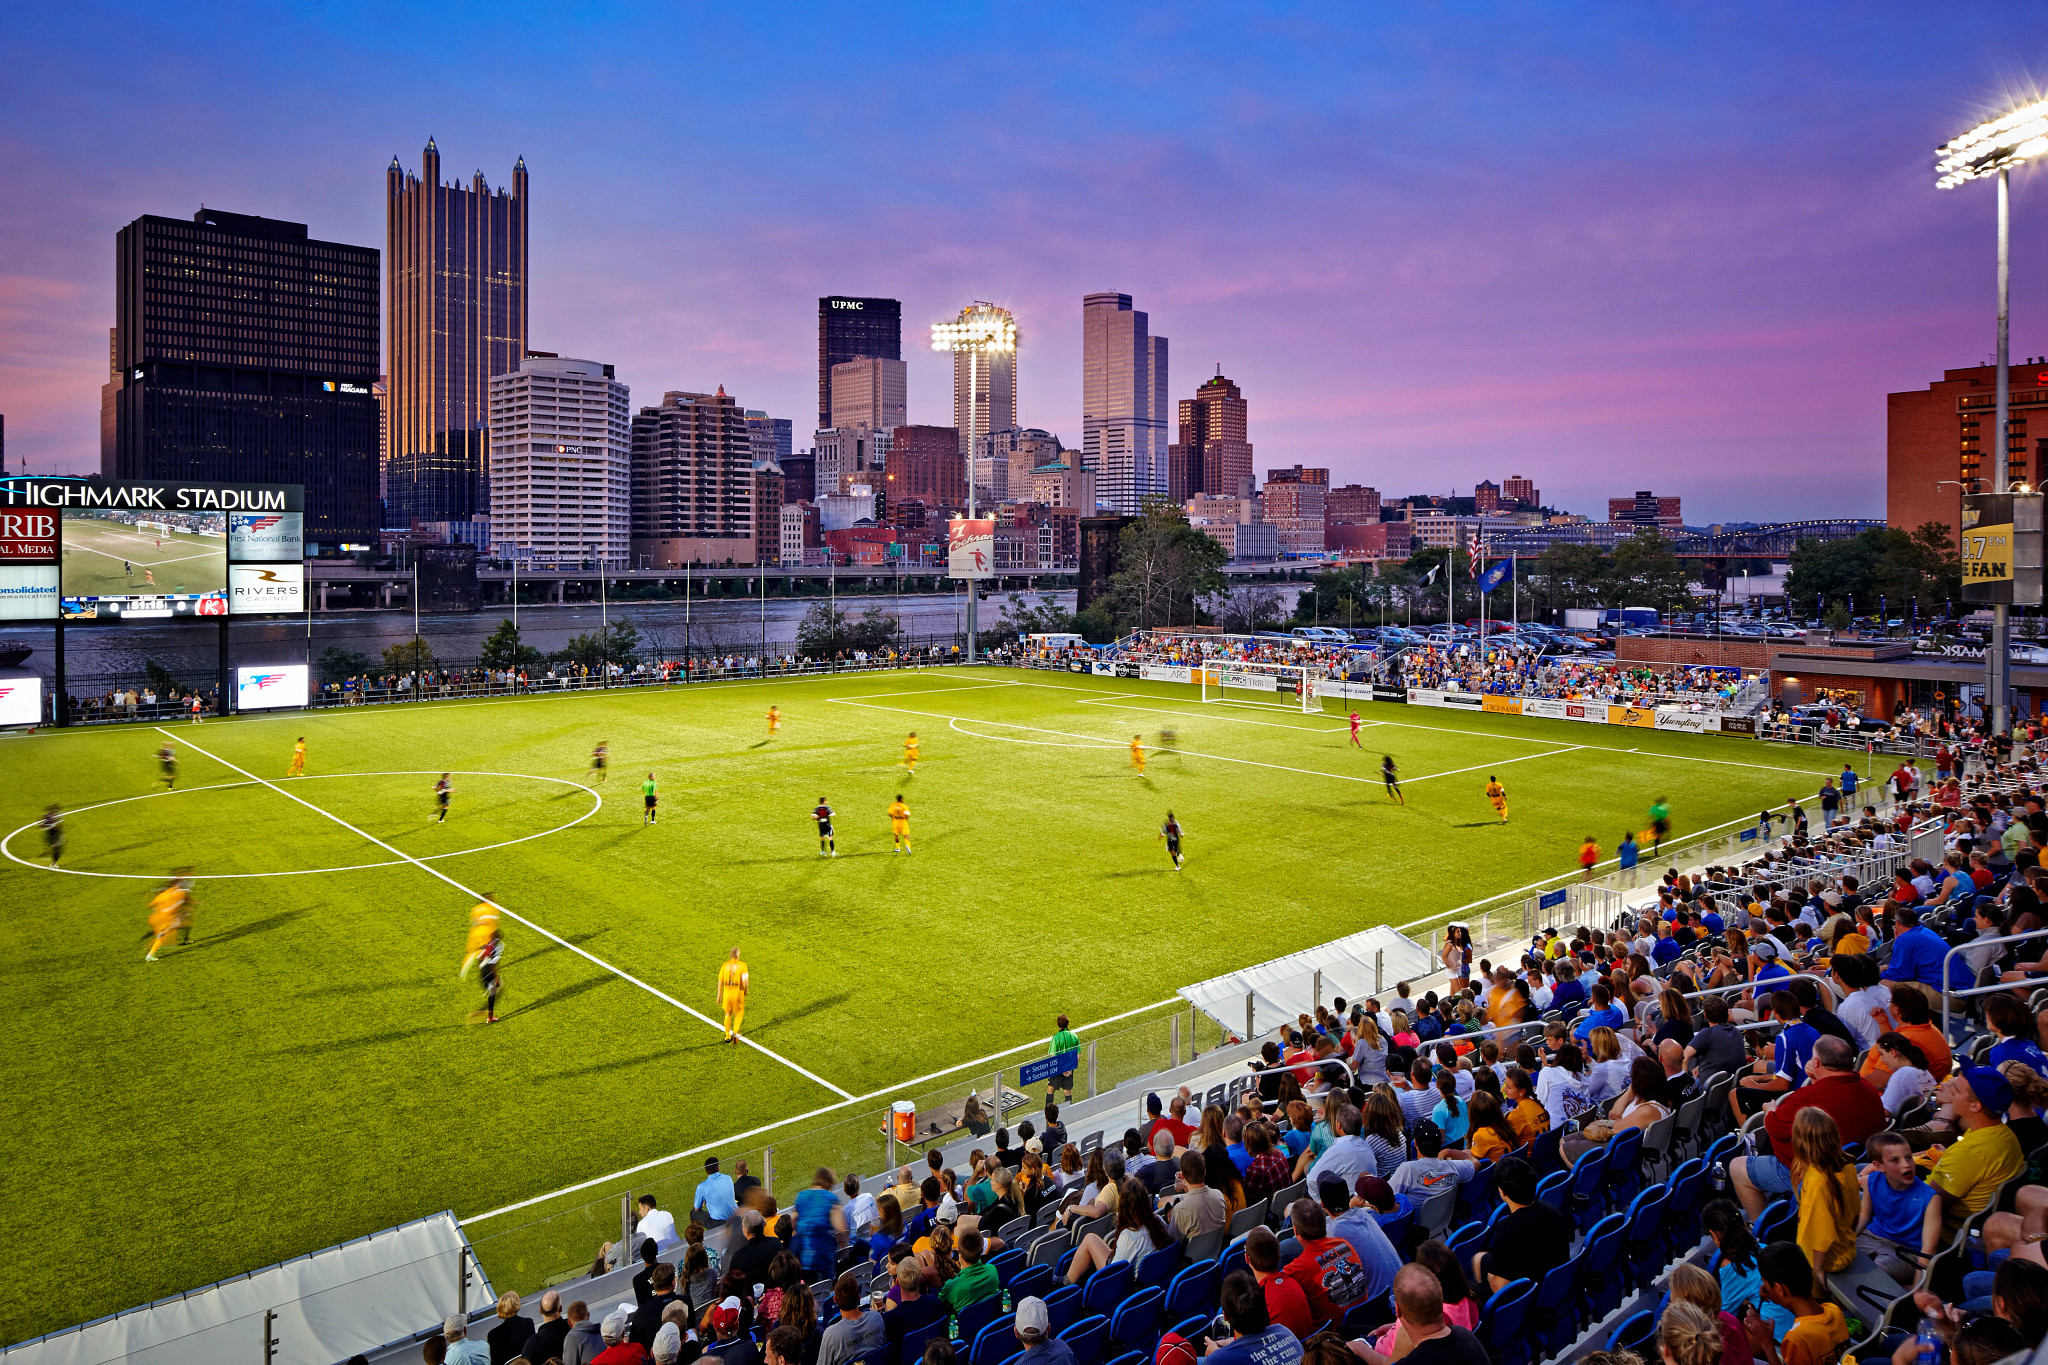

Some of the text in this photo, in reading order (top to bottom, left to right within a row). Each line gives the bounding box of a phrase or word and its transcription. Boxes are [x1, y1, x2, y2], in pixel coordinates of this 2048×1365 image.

[831, 300, 864, 310] UPMC
[8, 480, 286, 510] HIGHMARK STADIUM
[0, 508, 55, 538] RIB
[281, 535, 302, 543] Bank
[949, 534, 994, 552] Cochran
[1989, 536, 2006, 546] FM
[17, 543, 54, 554] MEDIA
[1972, 562, 2006, 578] FAN
[235, 587, 298, 595] RIVERS
[1655, 712, 1703, 729] Yuengling
[1032, 1063, 1048, 1072] Section
[1032, 1071, 1048, 1080] Section
[1249, 1335, 1295, 1363] the reason
[1279, 1346, 1298, 1360] rum
